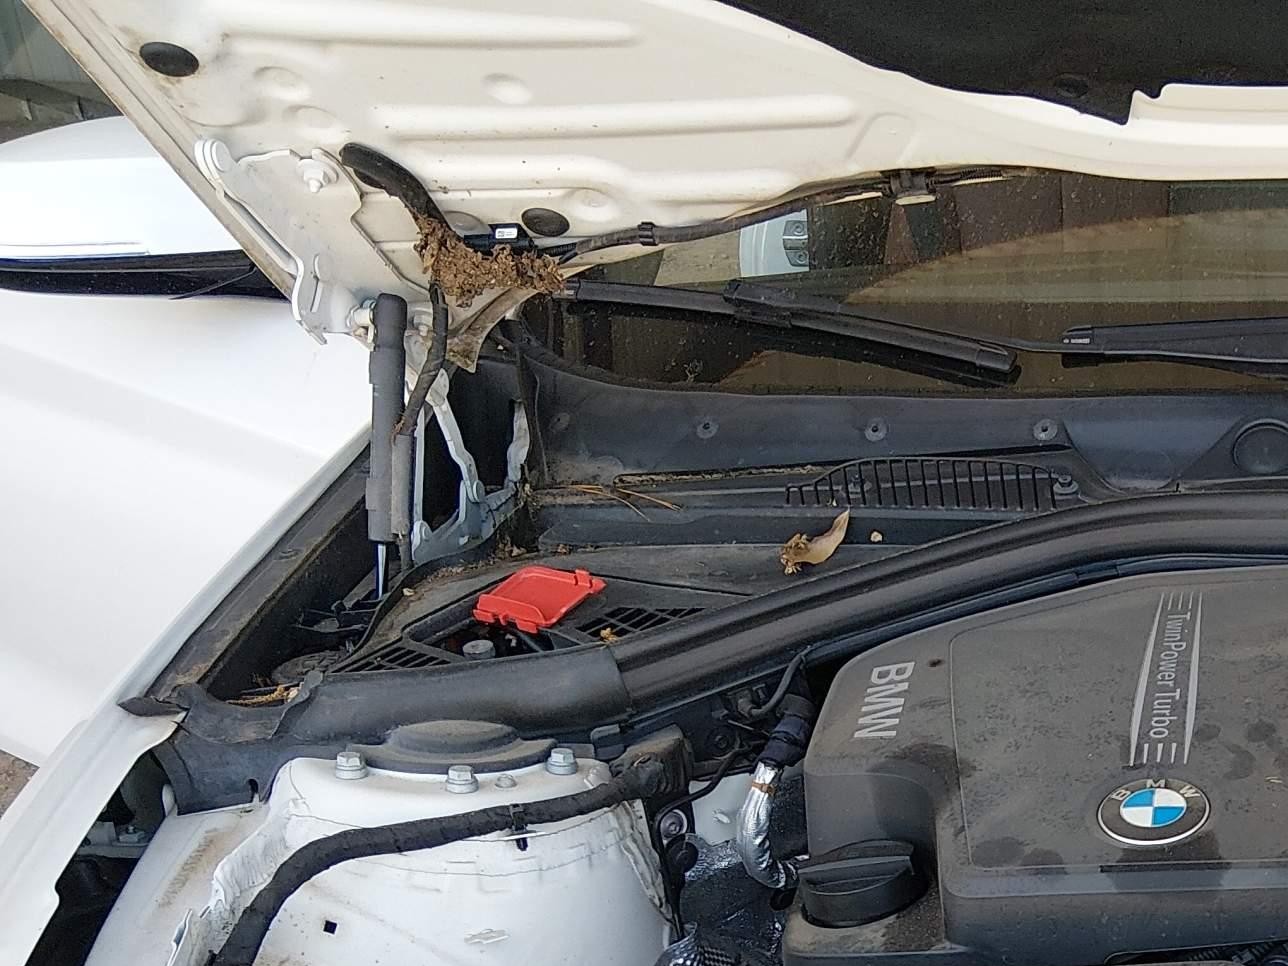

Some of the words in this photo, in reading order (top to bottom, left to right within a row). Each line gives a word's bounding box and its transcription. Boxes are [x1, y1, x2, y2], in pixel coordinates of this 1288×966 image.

[1157, 611, 1191, 687] TwinPower
[853, 661, 915, 738] BMW
[1149, 688, 1181, 738] Turbo
[1111, 779, 1201, 800] BMW
